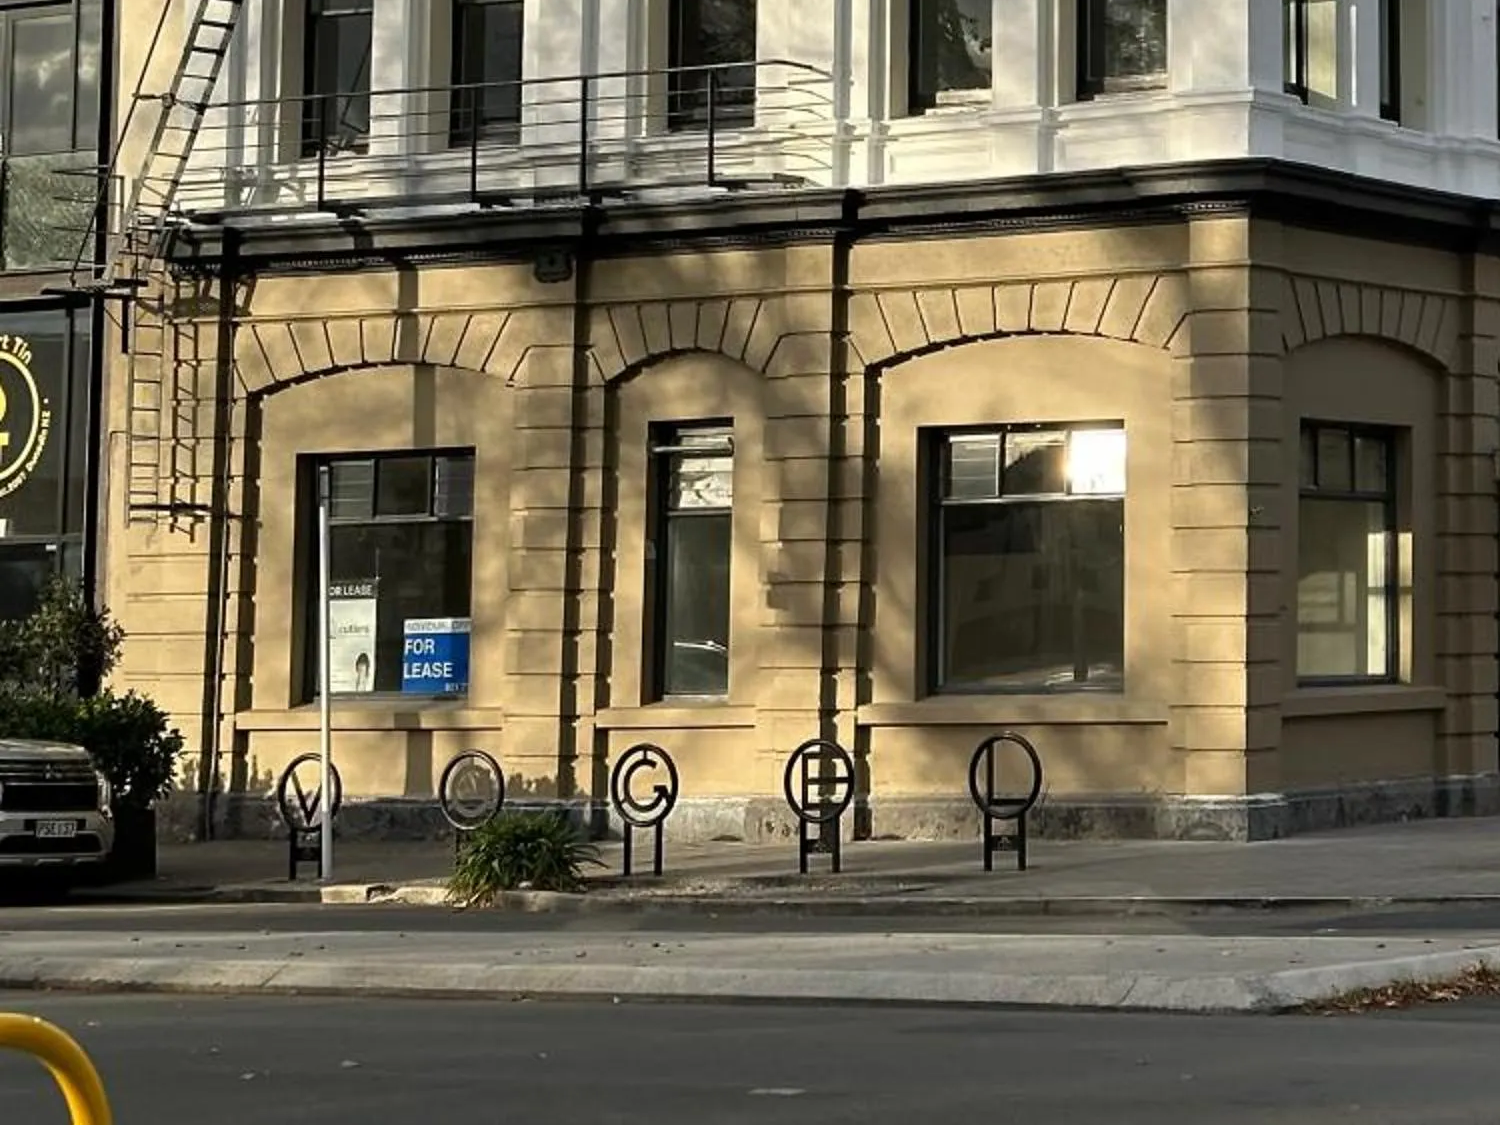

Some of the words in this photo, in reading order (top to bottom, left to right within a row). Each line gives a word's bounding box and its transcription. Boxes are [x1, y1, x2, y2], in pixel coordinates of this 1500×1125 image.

[12, 336, 32, 365] Tin
[328, 585, 342, 596] OR
[343, 584, 372, 596] LEASE
[404, 638, 435, 655] FOR
[403, 661, 453, 679] LEASE
